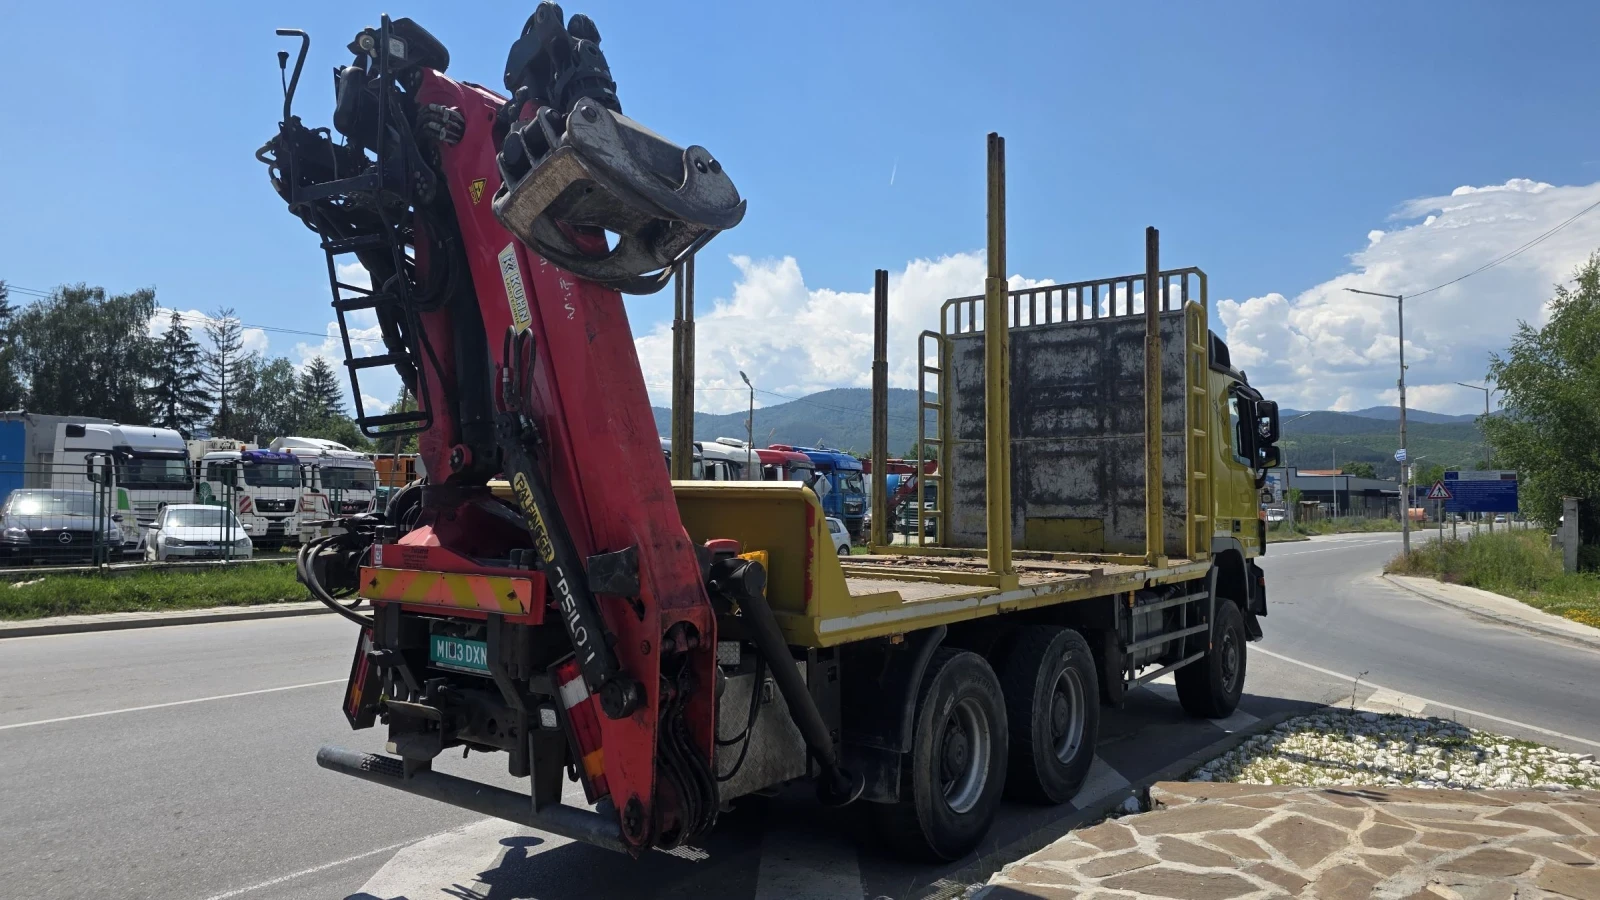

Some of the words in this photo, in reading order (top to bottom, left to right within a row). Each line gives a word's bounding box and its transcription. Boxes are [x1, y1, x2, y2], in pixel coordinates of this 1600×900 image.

[510, 273, 530, 324] KUHN
[516, 475, 552, 560] PALFINGER
[555, 566, 595, 665] PSILO
